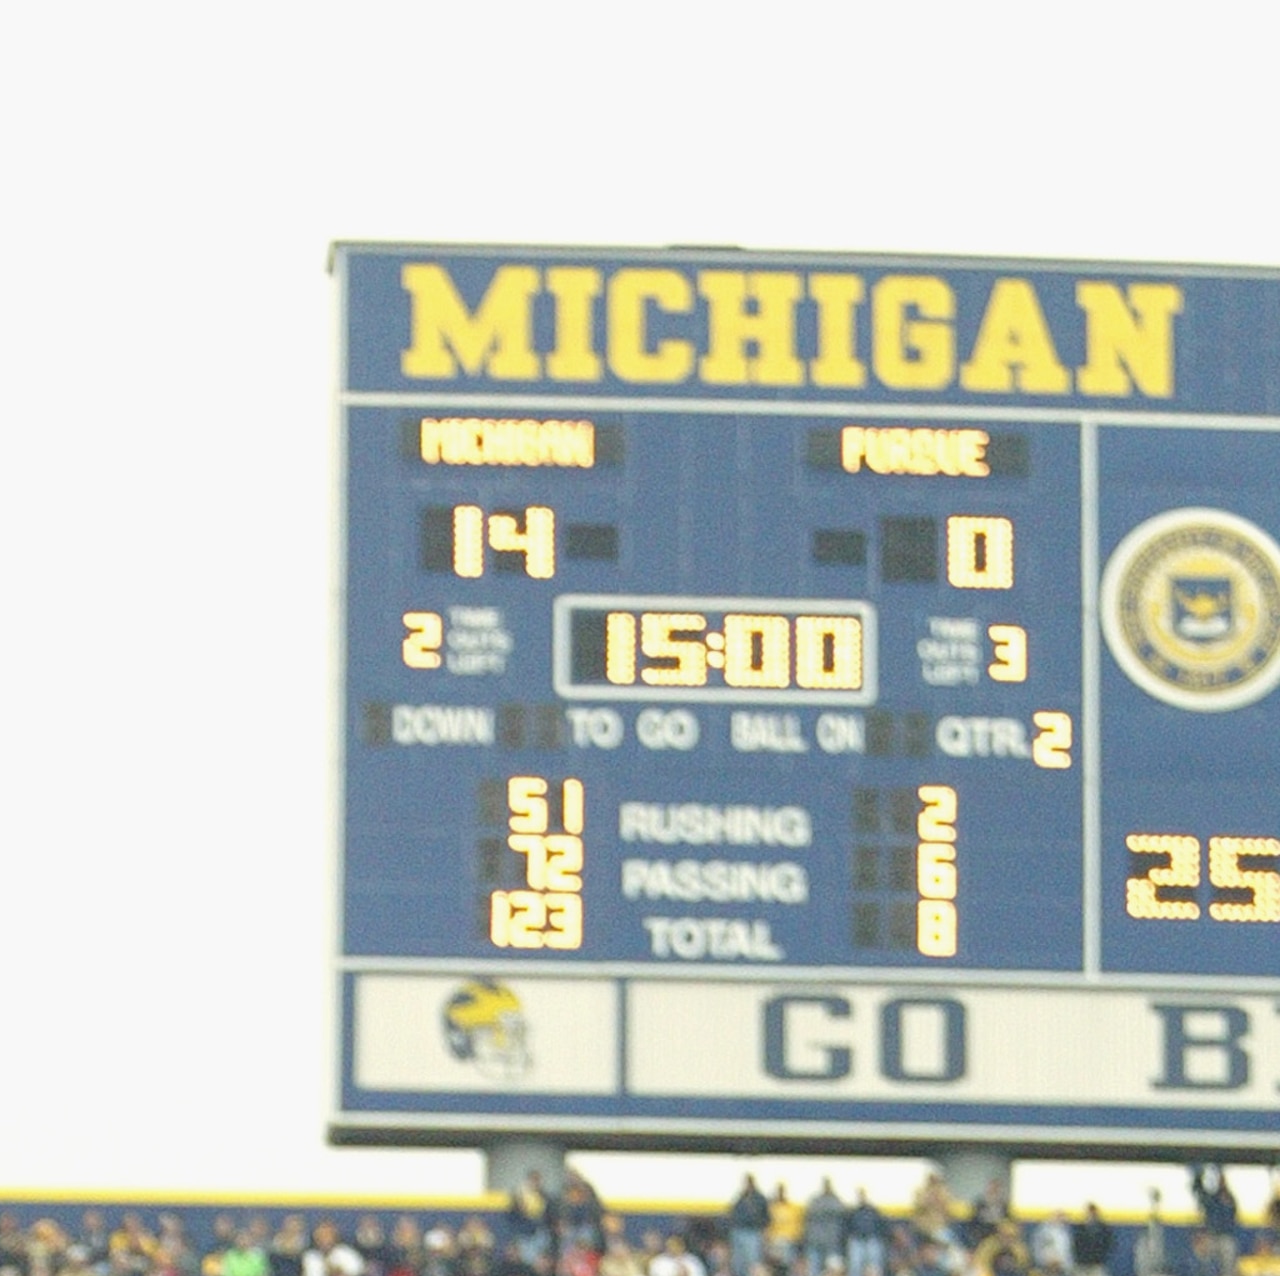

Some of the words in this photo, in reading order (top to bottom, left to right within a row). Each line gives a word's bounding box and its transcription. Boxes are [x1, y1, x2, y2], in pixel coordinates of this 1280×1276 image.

[401, 261, 1183, 398] MICHIGAN
[453, 505, 555, 579] 14
[946, 515, 1014, 589] 0
[402, 611, 442, 669] 2
[606, 612, 862, 689] 15:00
[987, 624, 1027, 682] 3
[391, 704, 495, 744] DOWN
[567, 708, 623, 749] TO
[636, 709, 700, 751] GO
[730, 712, 809, 753] BALL
[1032, 711, 1072, 769] 2
[508, 776, 584, 835] 51
[620, 802, 812, 848] RUSHING
[917, 785, 957, 842] 2
[508, 835, 584, 891] 72
[622, 860, 809, 905] PASSING
[917, 842, 957, 899] 6
[491, 890, 583, 949] 123
[643, 916, 784, 961] TOTAL
[764, 998, 966, 1082] GO
[1151, 1004, 1280, 1090] B
